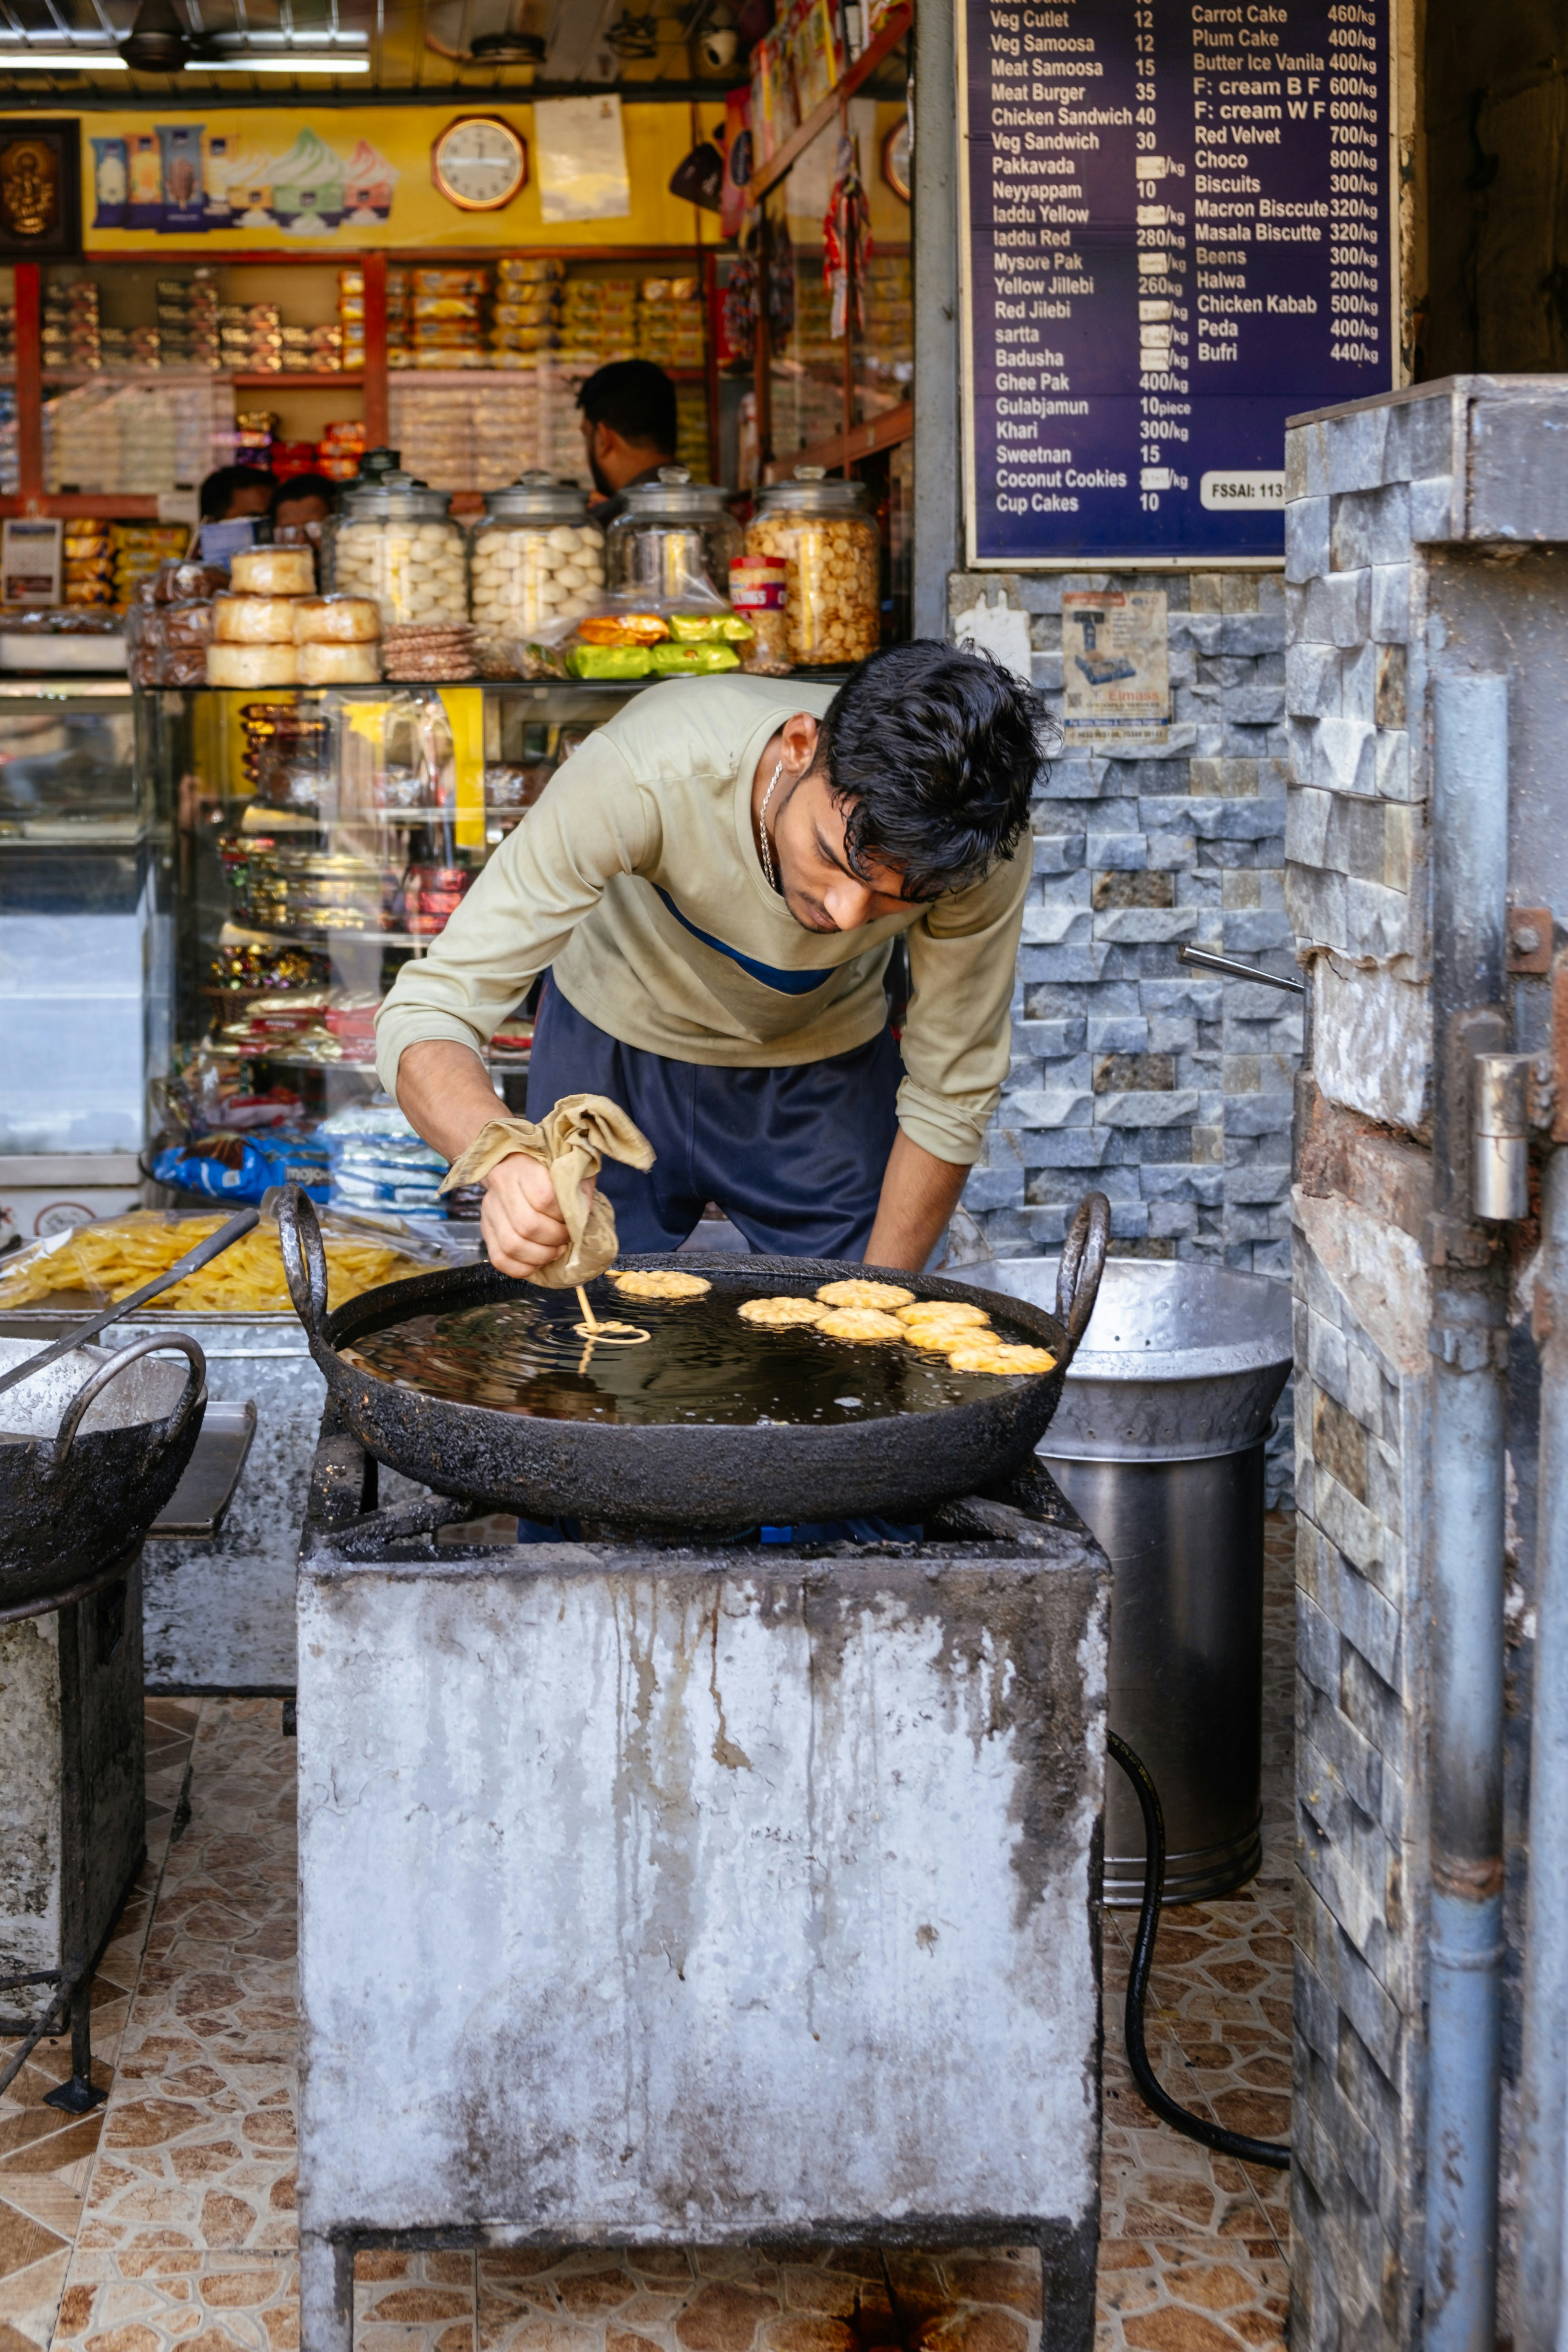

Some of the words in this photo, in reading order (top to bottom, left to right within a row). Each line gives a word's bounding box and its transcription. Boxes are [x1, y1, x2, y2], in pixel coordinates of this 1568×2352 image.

[990, 10, 1020, 32] Veg
[1023, 10, 1069, 28] Cutlet
[1134, 10, 1153, 28] 12
[1192, 5, 1243, 23] Carrot
[1247, 5, 1287, 23] Cake
[1328, 5, 1376, 26] 460/kg
[990, 34, 1020, 56] Veg
[1024, 33, 1095, 52] Samoosa
[1135, 34, 1154, 52] 12
[1193, 29, 1234, 46] Plum
[1239, 29, 1279, 47] Cake
[1328, 29, 1376, 50] 400/kg
[991, 58, 1029, 77] Meat
[1032, 58, 1103, 77] Samoosa
[1136, 58, 1155, 76] 15
[1194, 53, 1244, 71] Butter
[1248, 53, 1271, 71] Ice
[1275, 53, 1324, 71] Vanila
[1329, 53, 1377, 74] 400/kg
[991, 83, 1029, 102] Meat
[1032, 82, 1086, 105] Burger
[1136, 82, 1156, 101] 35
[1193, 77, 1212, 95] F:
[1219, 81, 1281, 95] cream
[1287, 77, 1302, 95] B
[1308, 77, 1321, 95] F
[1329, 77, 1377, 99] 600/kg
[991, 107, 1054, 126] Chicken
[1058, 106, 1133, 126] Sandwich
[1135, 106, 1156, 126] 40
[1194, 101, 1213, 119] F:
[1220, 105, 1282, 119] cream
[1287, 101, 1308, 119] W
[1313, 101, 1326, 119] F
[1329, 101, 1377, 123] 600/kg
[991, 132, 1021, 155] Veg
[1024, 131, 1100, 150] Sandwich
[1136, 131, 1157, 150] 30
[1195, 126, 1227, 145] Red
[1231, 125, 1281, 144] Velvet
[1330, 126, 1378, 147] 700/kg
[992, 156, 1075, 175] Pakkavada
[1195, 150, 1249, 169] Choco
[1330, 150, 1378, 171] 800/kg
[992, 180, 1082, 203] Neyyappam
[1137, 180, 1157, 199] 10
[1195, 174, 1261, 193] Biscuits
[1330, 174, 1378, 196] 300/kg
[1039, 205, 1090, 224] Yellow
[1195, 198, 1255, 218] Macron
[1259, 198, 1329, 218] Bisccute
[1330, 198, 1378, 220] 320/kg
[1040, 229, 1071, 247] Red
[1136, 229, 1186, 250] 280/kg
[1195, 223, 1252, 241] Masala
[1255, 223, 1322, 241] Biscutte
[1330, 223, 1378, 244] 320/kg
[994, 252, 1050, 274] Mysore
[1054, 252, 1083, 270] Pak
[1196, 247, 1247, 265] Beens
[1330, 246, 1378, 268] 300/kg
[994, 276, 1045, 295] Yellow
[1048, 276, 1094, 294] Jillebi
[1138, 276, 1183, 297] 260kg
[1197, 271, 1246, 289] Halwa
[1330, 270, 1378, 292] 200/kg
[995, 300, 1026, 319] Red
[1029, 300, 1071, 319] Jilebi
[1197, 294, 1263, 313] Chicken
[1266, 294, 1317, 313] Kabab
[1331, 294, 1379, 316] 500/kg
[995, 326, 1040, 343] sartta
[1198, 318, 1239, 337] Peda
[1330, 318, 1378, 340] 400/kg
[995, 348, 1064, 367] Badusha
[1198, 342, 1237, 361] Bufri
[1330, 342, 1379, 364] 440/kg
[995, 372, 1037, 392] Ghee
[1040, 372, 1070, 391] Pak
[1139, 372, 1189, 394] 400/kg
[995, 397, 1089, 419] Gulabjamun
[1140, 396, 1191, 418] 10piece
[996, 421, 1038, 439] Khari
[1140, 420, 1189, 442] 300/kg
[996, 445, 1071, 464] Sweetnan
[1140, 444, 1160, 463] 15
[996, 469, 1062, 488] Coconut
[1065, 468, 1128, 488] Cookies
[1212, 483, 1255, 498] FSSAI:
[1260, 483, 1285, 498] 113
[996, 493, 1029, 516] Cup
[1031, 493, 1079, 512] Cakes
[1139, 492, 1160, 511] 10
